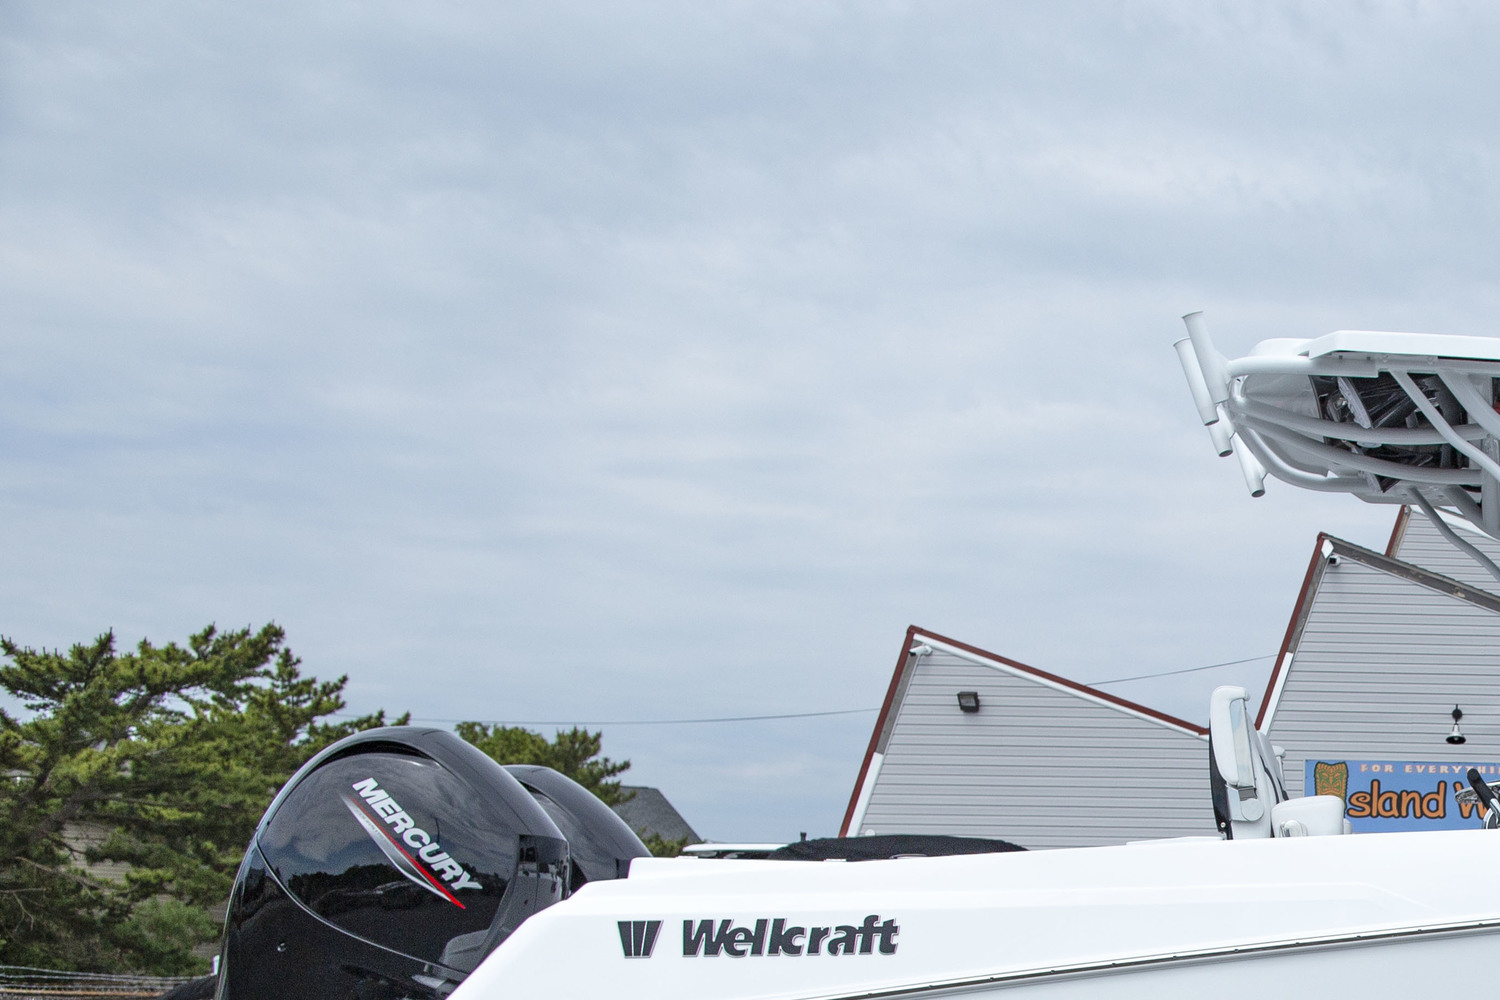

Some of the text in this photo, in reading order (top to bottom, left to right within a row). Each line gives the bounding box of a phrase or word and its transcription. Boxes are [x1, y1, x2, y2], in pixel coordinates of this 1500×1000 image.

[1360, 764, 1394, 773] FOR
[352, 777, 483, 890] MERCURY
[682, 914, 899, 957] Wellcraft
